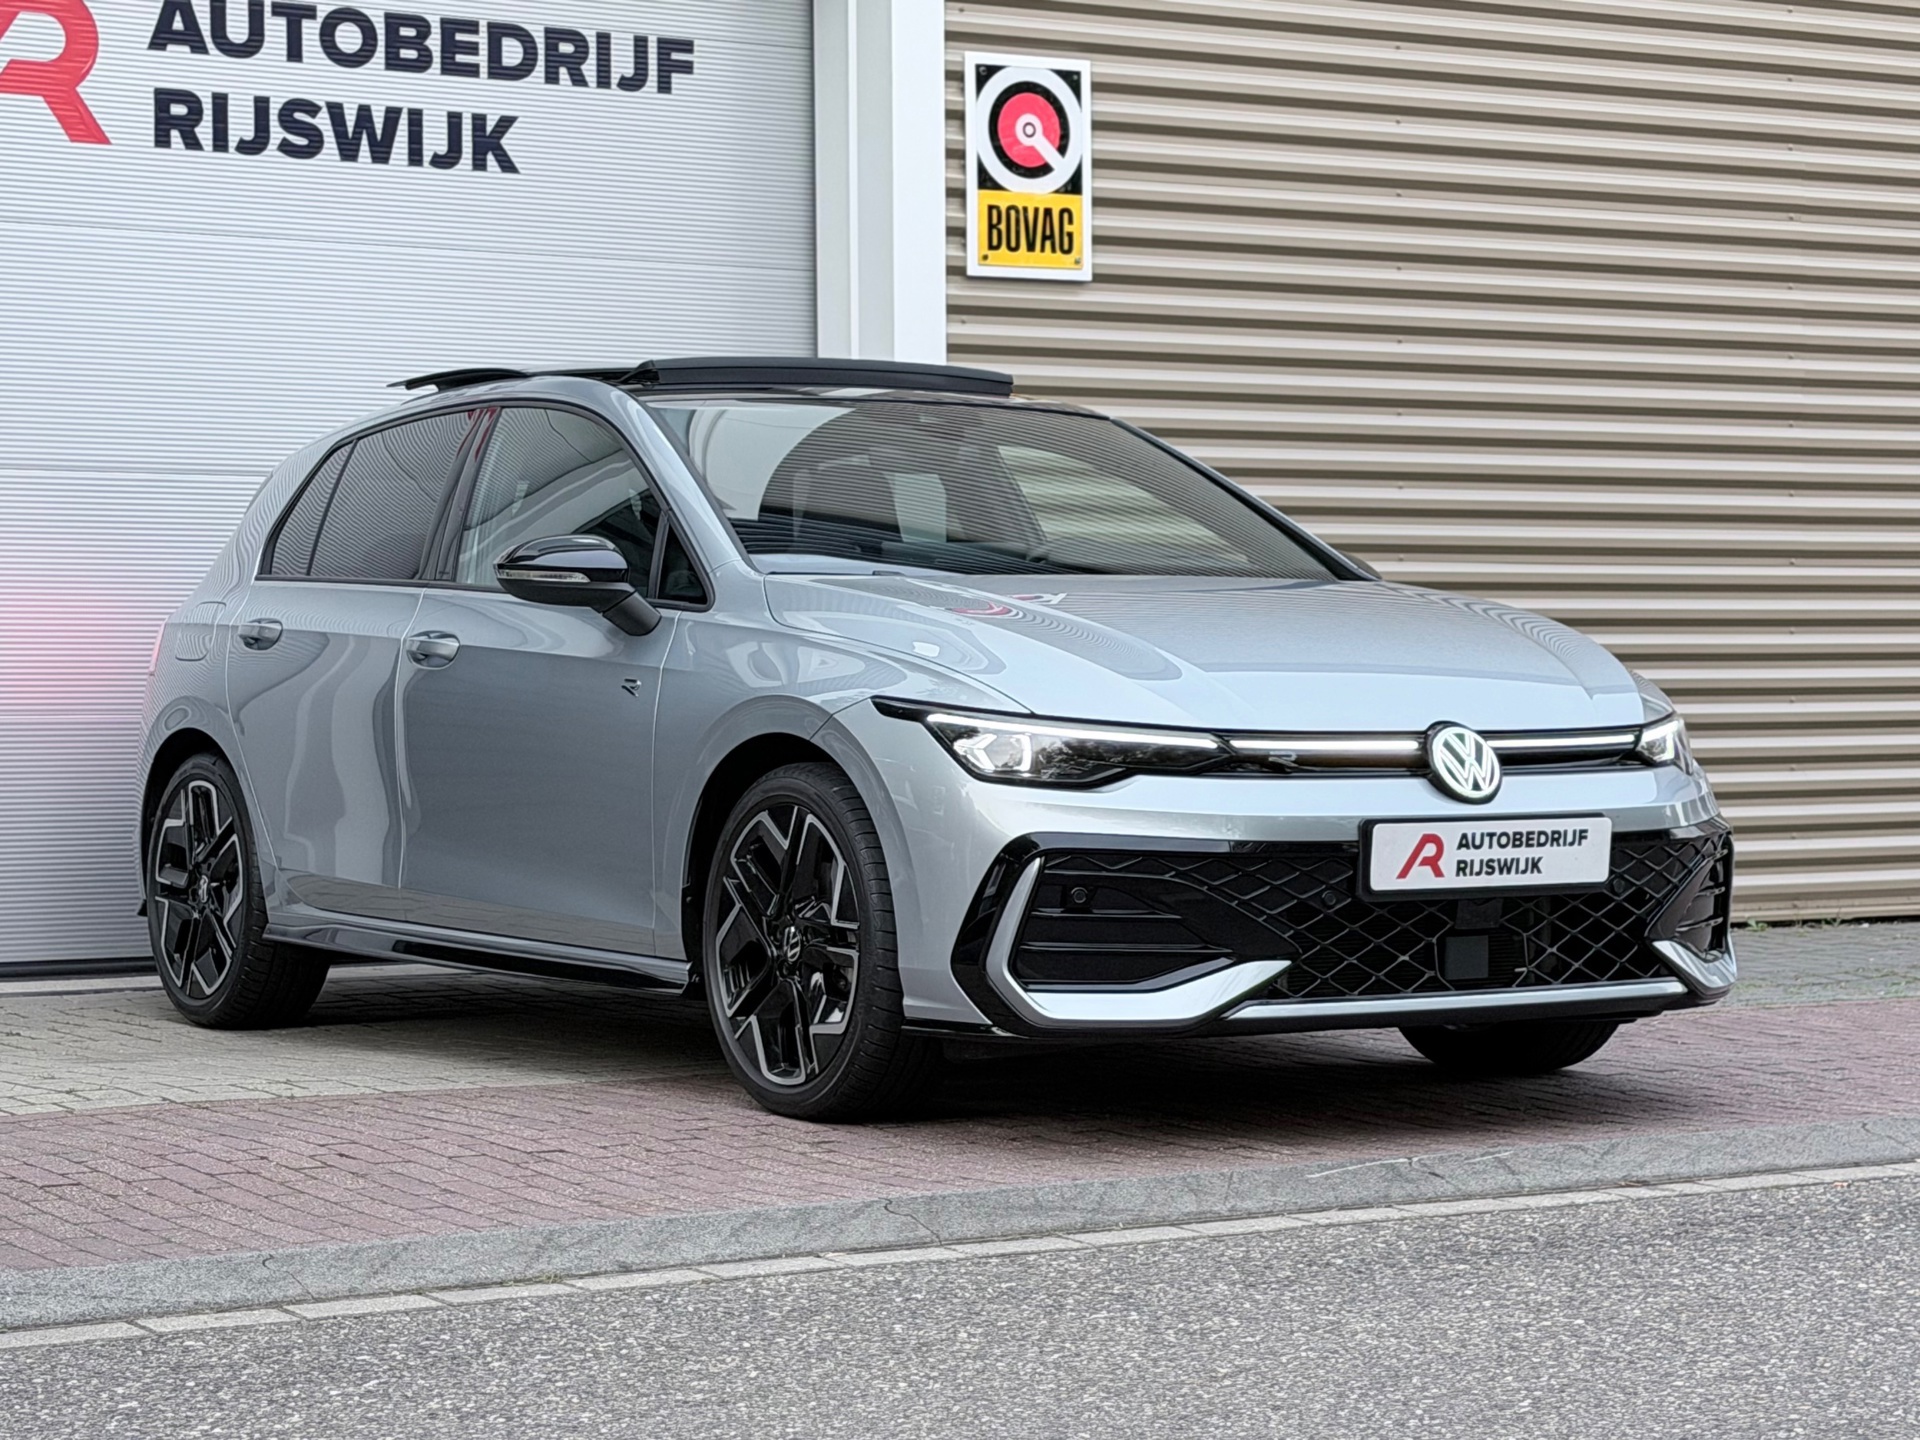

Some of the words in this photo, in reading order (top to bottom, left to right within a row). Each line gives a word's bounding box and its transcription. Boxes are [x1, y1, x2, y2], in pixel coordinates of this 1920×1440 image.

[147, 0, 695, 94] AUTOBEDRIJF
[153, 87, 521, 174] RIJSWIJK
[987, 204, 1074, 255] BOVAG
[1456, 829, 1589, 850] AUTOBEDRIJF
[1455, 857, 1543, 877] RIJSWIJK
